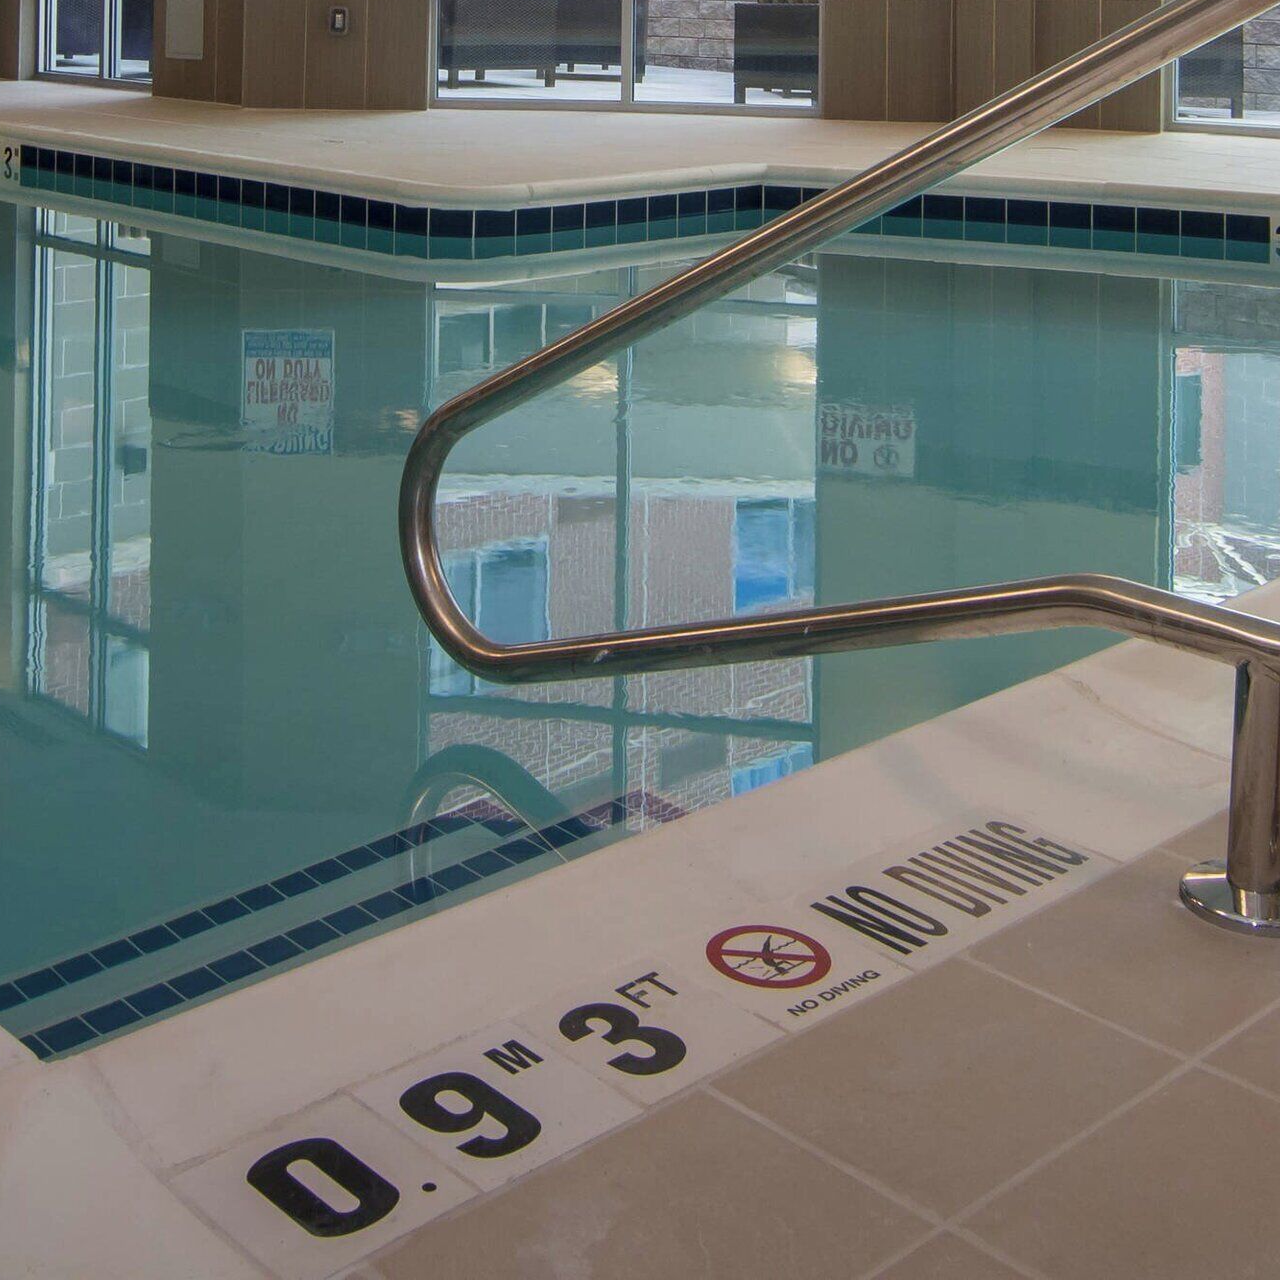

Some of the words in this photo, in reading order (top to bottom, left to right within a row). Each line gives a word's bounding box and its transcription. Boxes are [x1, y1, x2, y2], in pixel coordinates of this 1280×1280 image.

[810, 885, 949, 955] NO
[881, 821, 1089, 918] DIVING
[615, 972, 678, 1008] FT
[787, 999, 819, 1017] NO
[818, 969, 881, 1002] DIVING
[559, 1002, 686, 1076] 3
[246, 1072, 542, 1238] 0.9
[483, 1039, 544, 1074] M
